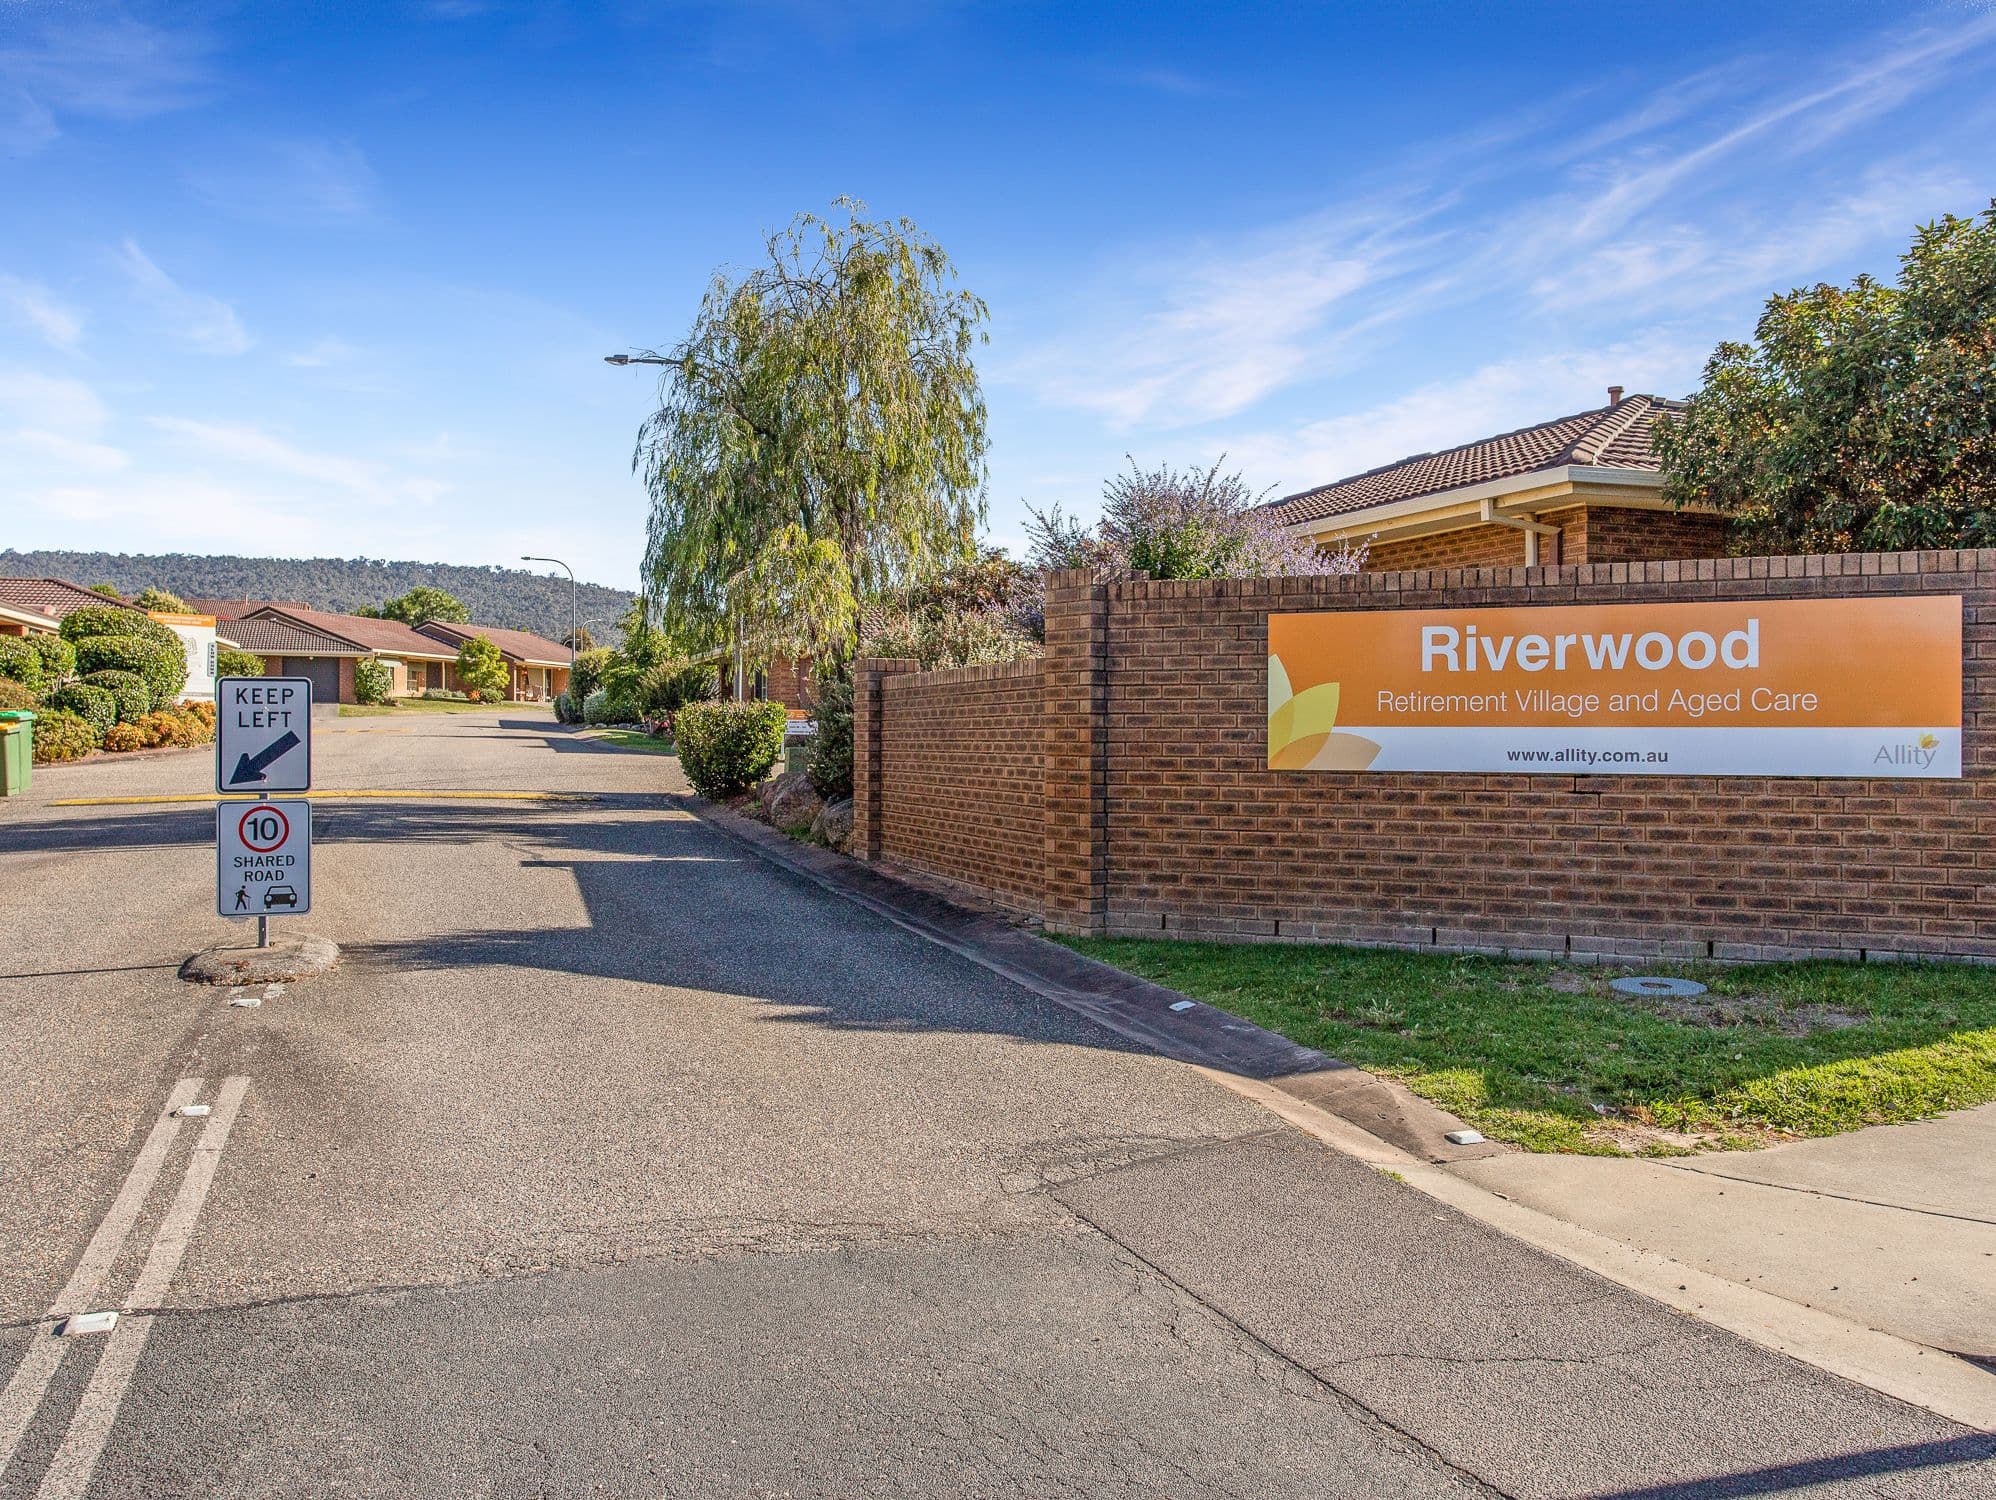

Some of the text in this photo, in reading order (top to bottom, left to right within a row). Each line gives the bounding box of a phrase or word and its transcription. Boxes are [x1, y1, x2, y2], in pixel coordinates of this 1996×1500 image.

[1421, 618, 1759, 672] Riverwood
[236, 687, 294, 705] KEEP
[1377, 687, 1818, 718] Retirement Village and Aged Care
[238, 711, 292, 728] LEFT
[1507, 749, 1669, 765] www.allity.com.au
[1873, 744, 1937, 770] Allity
[247, 817, 279, 841] 10
[233, 855, 295, 868] SHARED
[244, 869, 285, 882] ROAD
